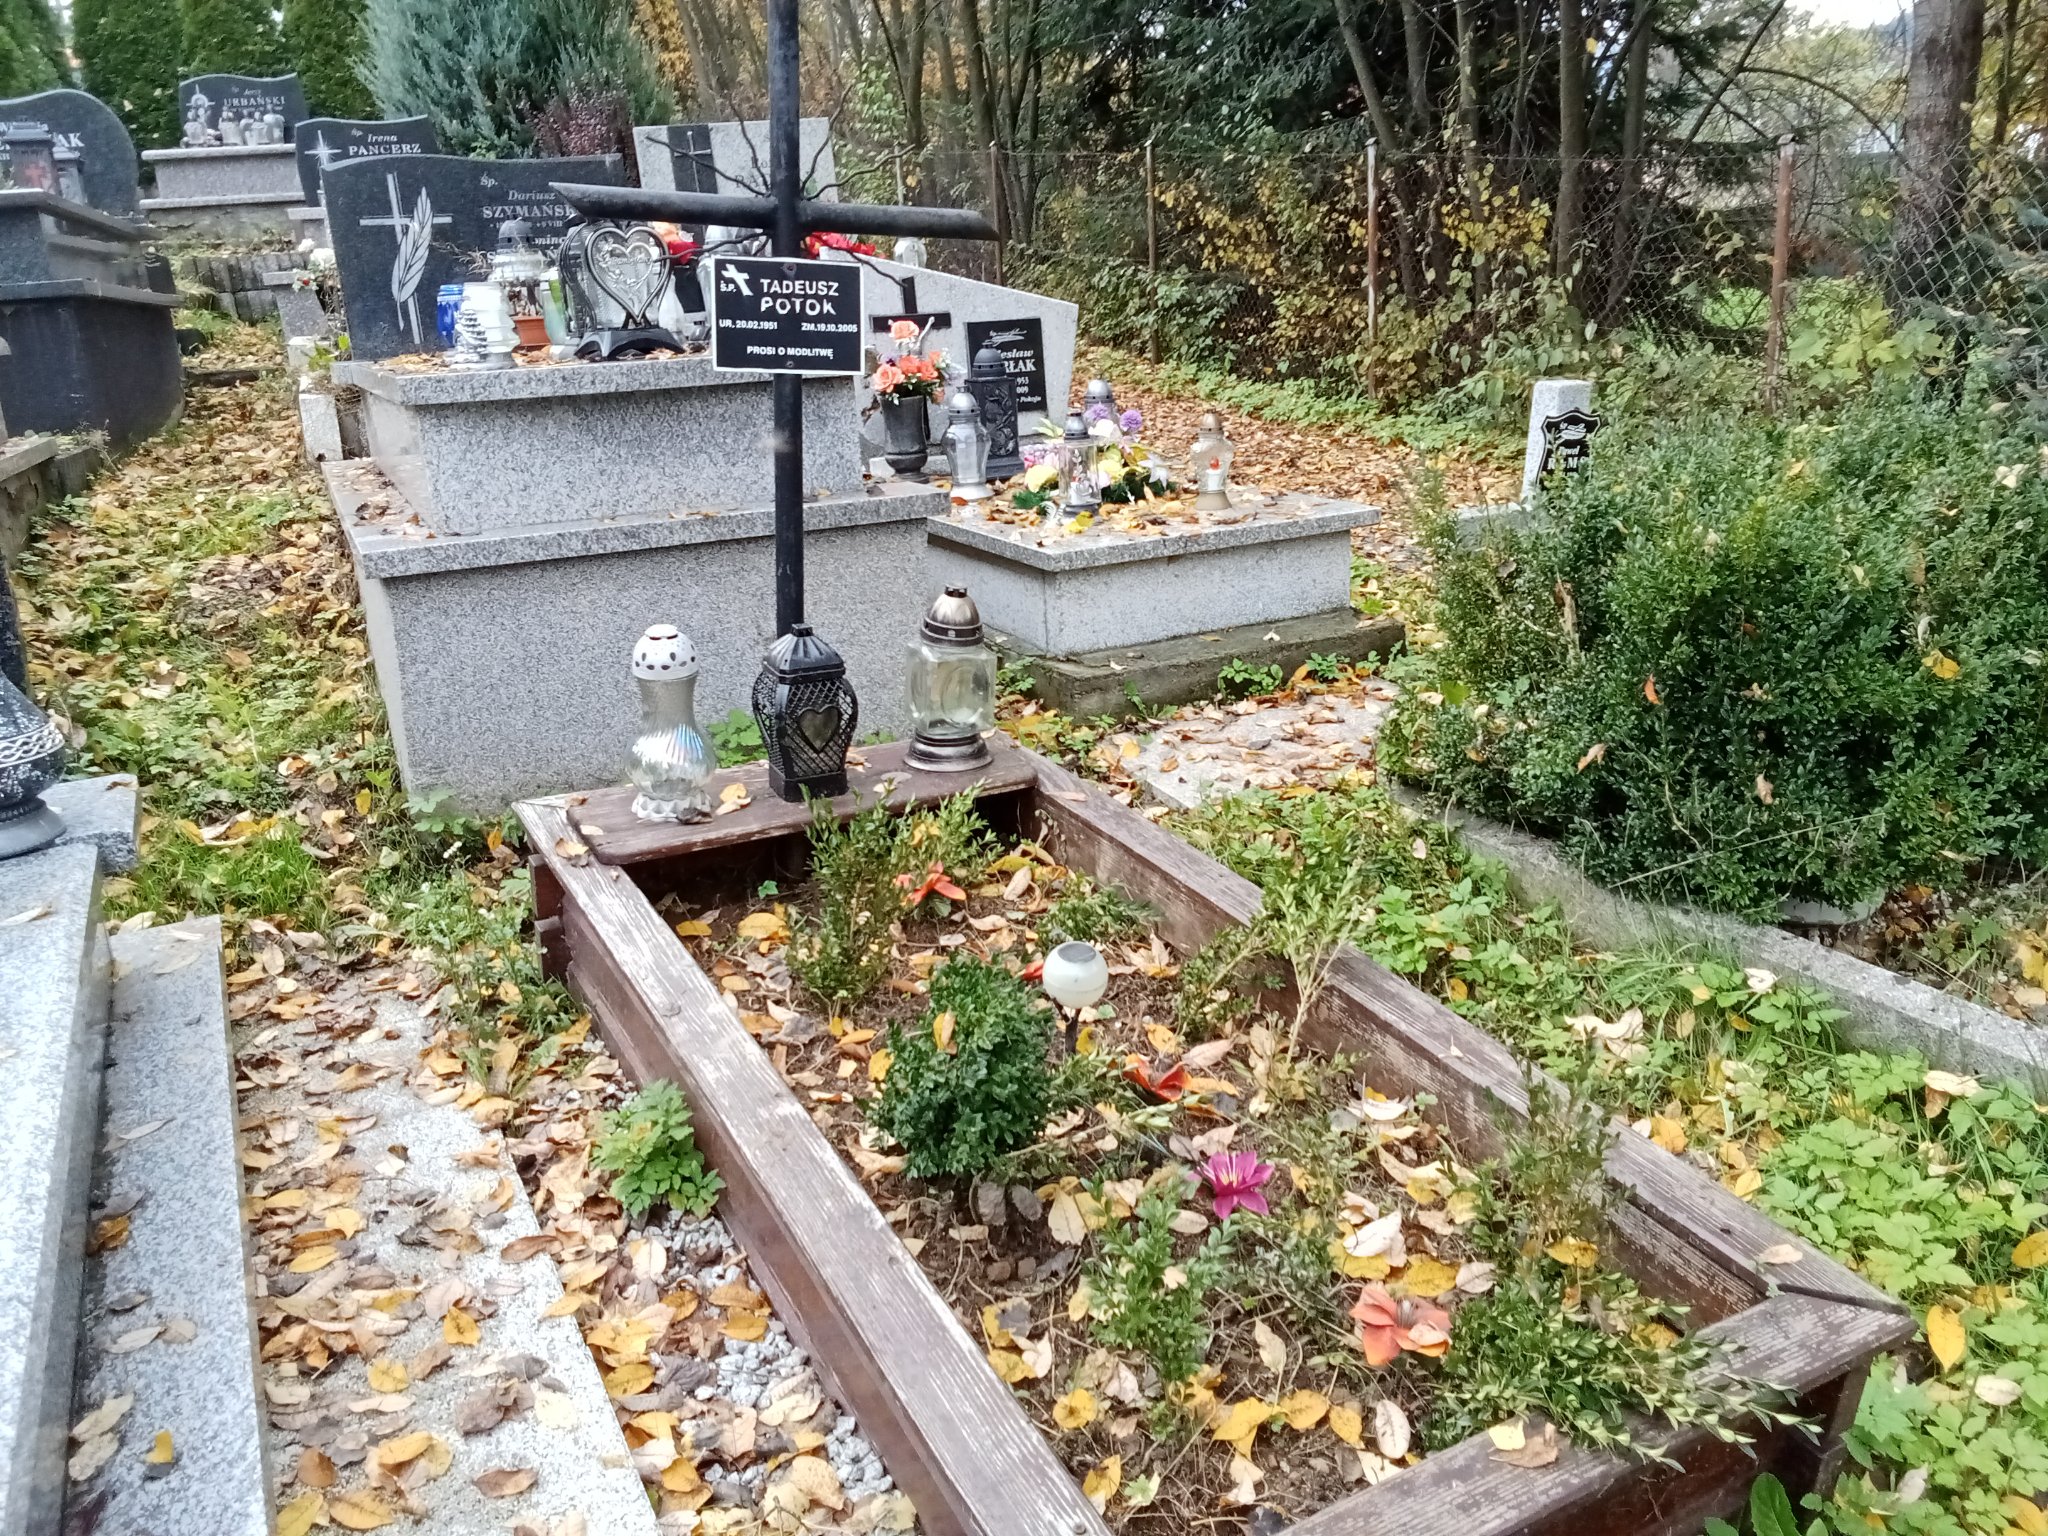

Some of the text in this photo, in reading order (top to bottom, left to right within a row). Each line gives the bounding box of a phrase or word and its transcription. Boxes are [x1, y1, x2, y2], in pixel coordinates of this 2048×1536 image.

[223, 95, 286, 107] URBAŃSKI
[367, 133, 399, 143] Irena
[348, 143, 422, 156] PANCERZ
[508, 189, 556, 201] Dariusz
[482, 202, 577, 219] SZYMAŃSK
[759, 278, 840, 297] TADEUSZ
[760, 297, 837, 316] POTOK
[736, 319, 778, 330] 20.02.1951
[746, 345, 834, 360] PROSI O MODLITWĘ
